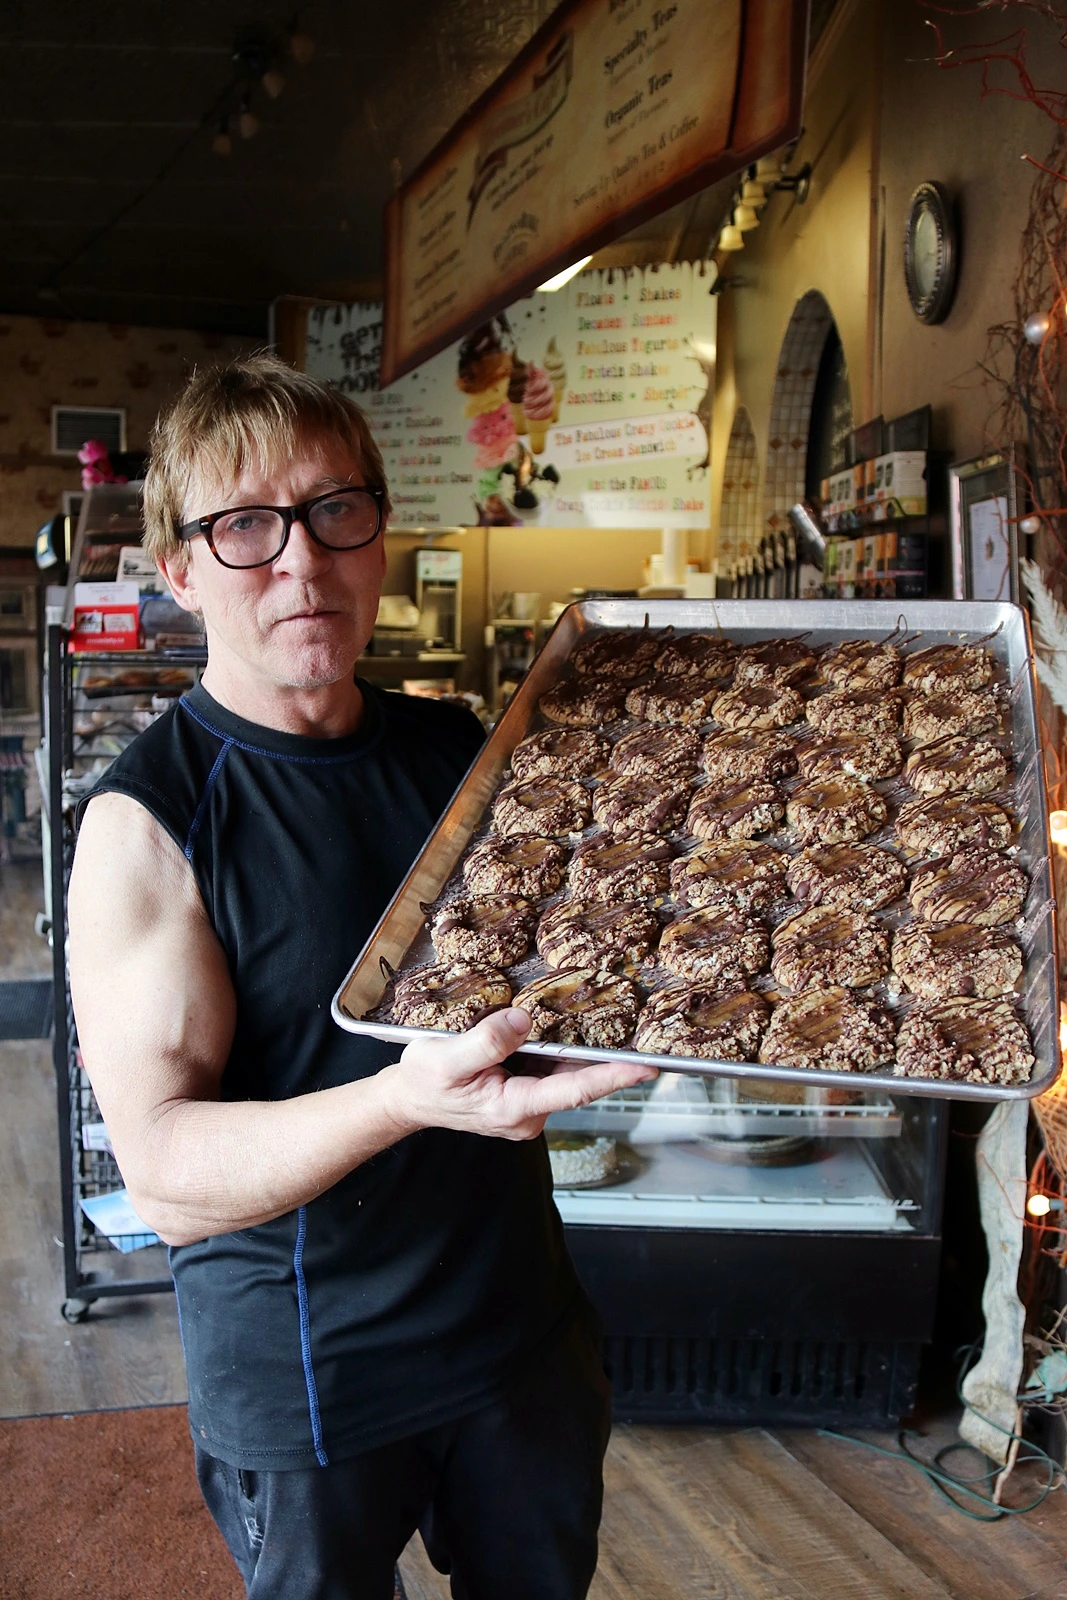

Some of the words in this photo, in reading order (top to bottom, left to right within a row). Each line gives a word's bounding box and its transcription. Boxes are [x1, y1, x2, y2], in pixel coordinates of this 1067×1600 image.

[653, 4, 678, 31] Teas
[604, 91, 643, 128] Organic
[648, 71, 672, 95] Teas
[670, 115, 699, 141] Coffee
[576, 290, 616, 308] Floats
[639, 286, 681, 302] Shakes
[576, 340, 628, 355] Fabulous
[631, 337, 679, 354] Yogurts
[580, 364, 624, 379] Protein
[629, 362, 670, 378] Shakes
[568, 388, 624, 405] Smoothies
[554, 432, 573, 446] The
[576, 426, 622, 443] Fabulous
[624, 422, 656, 437] Crazy
[658, 417, 695, 433] Cookie
[576, 448, 591, 462] Ice
[594, 445, 624, 461] Cream
[628, 438, 677, 457] Sandwich
[609, 476, 627, 491] the
[556, 498, 585, 513] Crazy
[671, 496, 705, 512] Shake
